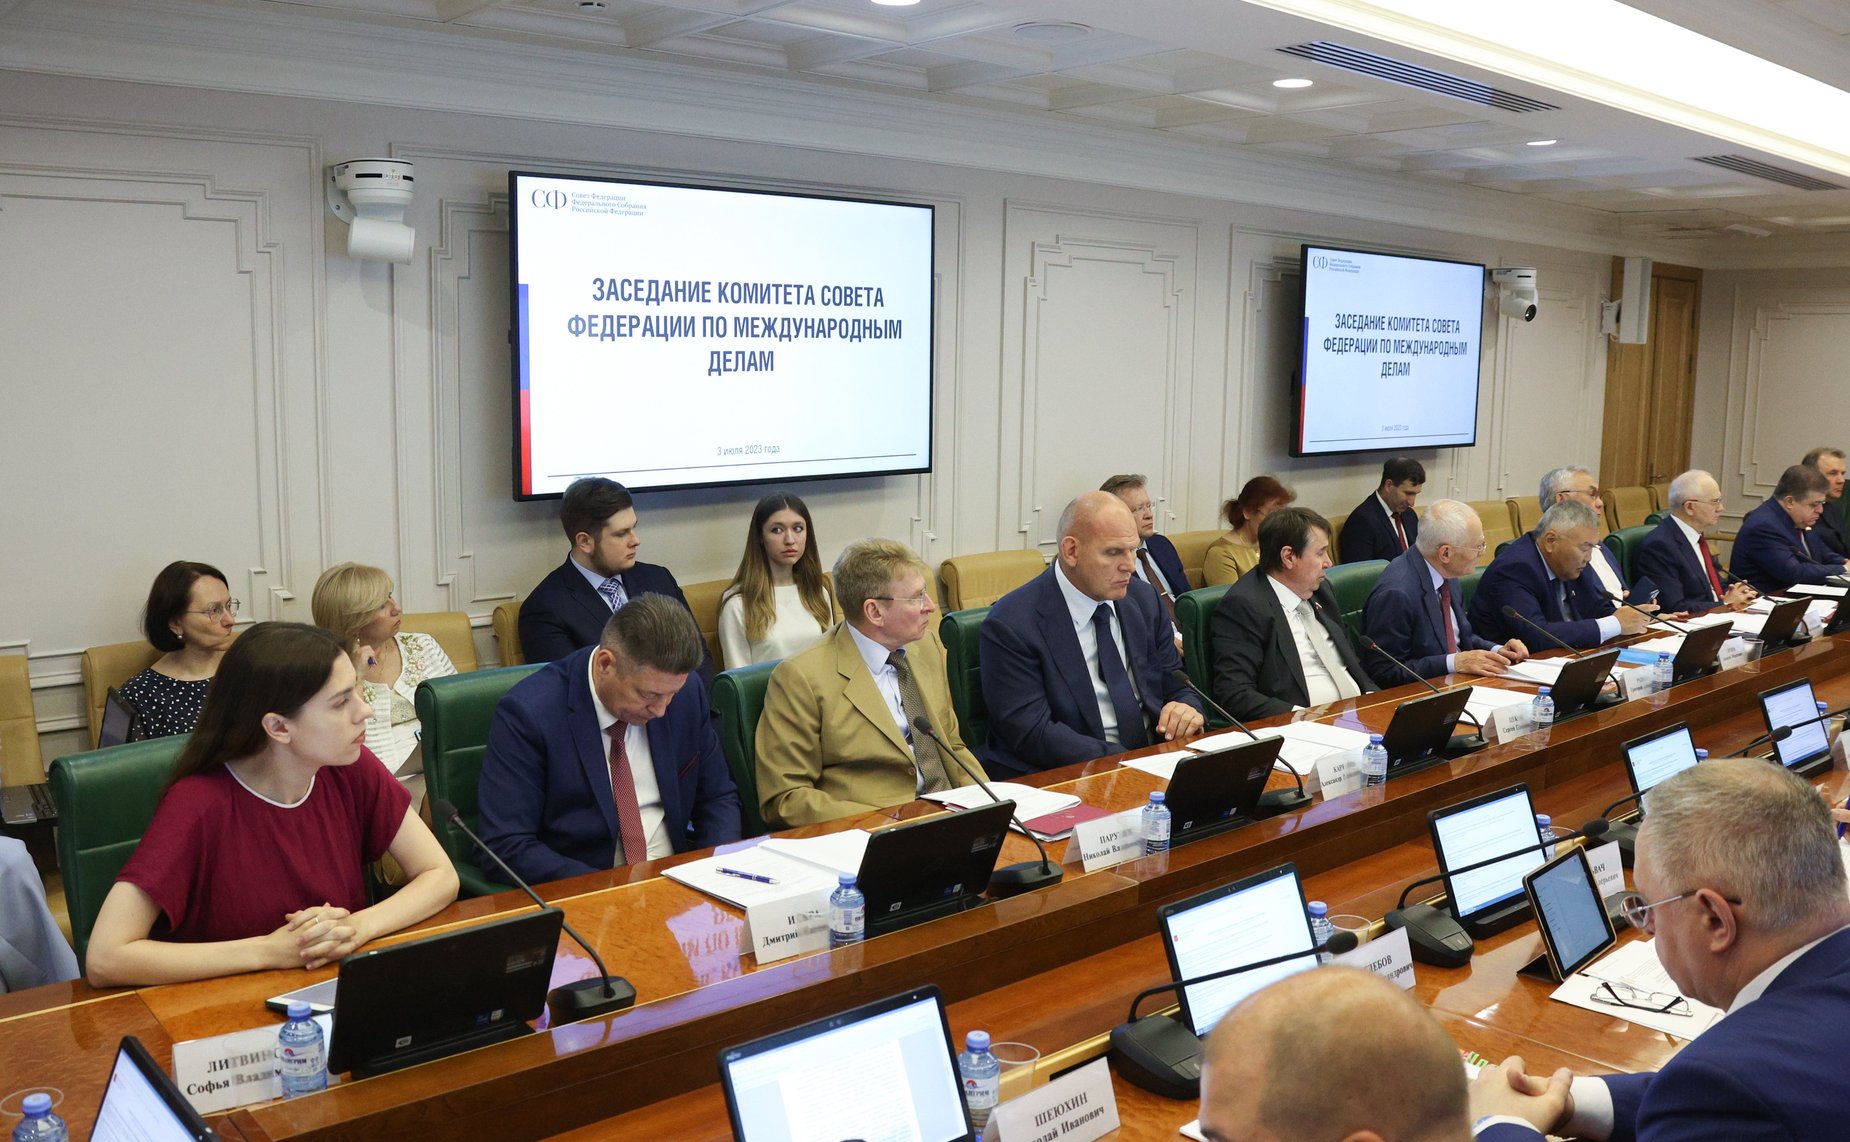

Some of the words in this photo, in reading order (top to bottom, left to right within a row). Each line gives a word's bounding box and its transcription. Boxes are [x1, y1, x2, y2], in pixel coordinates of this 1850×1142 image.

[531, 188, 567, 210] СФ
[571, 192, 590, 200] Совет
[590, 193, 627, 202] Федерации
[609, 208, 644, 217] Федерации
[592, 277, 712, 307] ЗАСЕДАНИЕ
[718, 281, 816, 306] КОМИТЕТА
[821, 284, 885, 308] СОВЕТА
[567, 314, 696, 342] ФЕДЕРАЦИИ
[702, 315, 728, 339] ПО
[733, 316, 902, 343] МЕЖДУНАРОДНЫМ
[1334, 313, 1386, 333] ЗАСЕДАНИЕ
[1387, 316, 1430, 333] КОМИТЕТА
[1432, 318, 1460, 334] СОВЕТА
[1323, 336, 1378, 356] ФЕДЕРАЦИИ
[1379, 338, 1392, 354] ПО
[1393, 339, 1468, 358] МЕЖДУНАРОДНЫМ
[707, 350, 774, 377] ДЕЛАМ
[1380, 361, 1411, 379] ДЕЛАМ
[716, 446, 722, 457] 3
[723, 447, 743, 456] июля
[744, 444, 763, 455] 2023
[764, 445, 781, 454] года
[1083, 848, 1110, 862] Николай
[1592, 863, 1606, 875] ВАЧ
[187, 1080, 229, 1096] Софья
[1034, 1092, 1088, 1127] ШЕЮХИН
[1031, 1127, 1059, 1142] олай
[1061, 1106, 1105, 1134] Иванович
